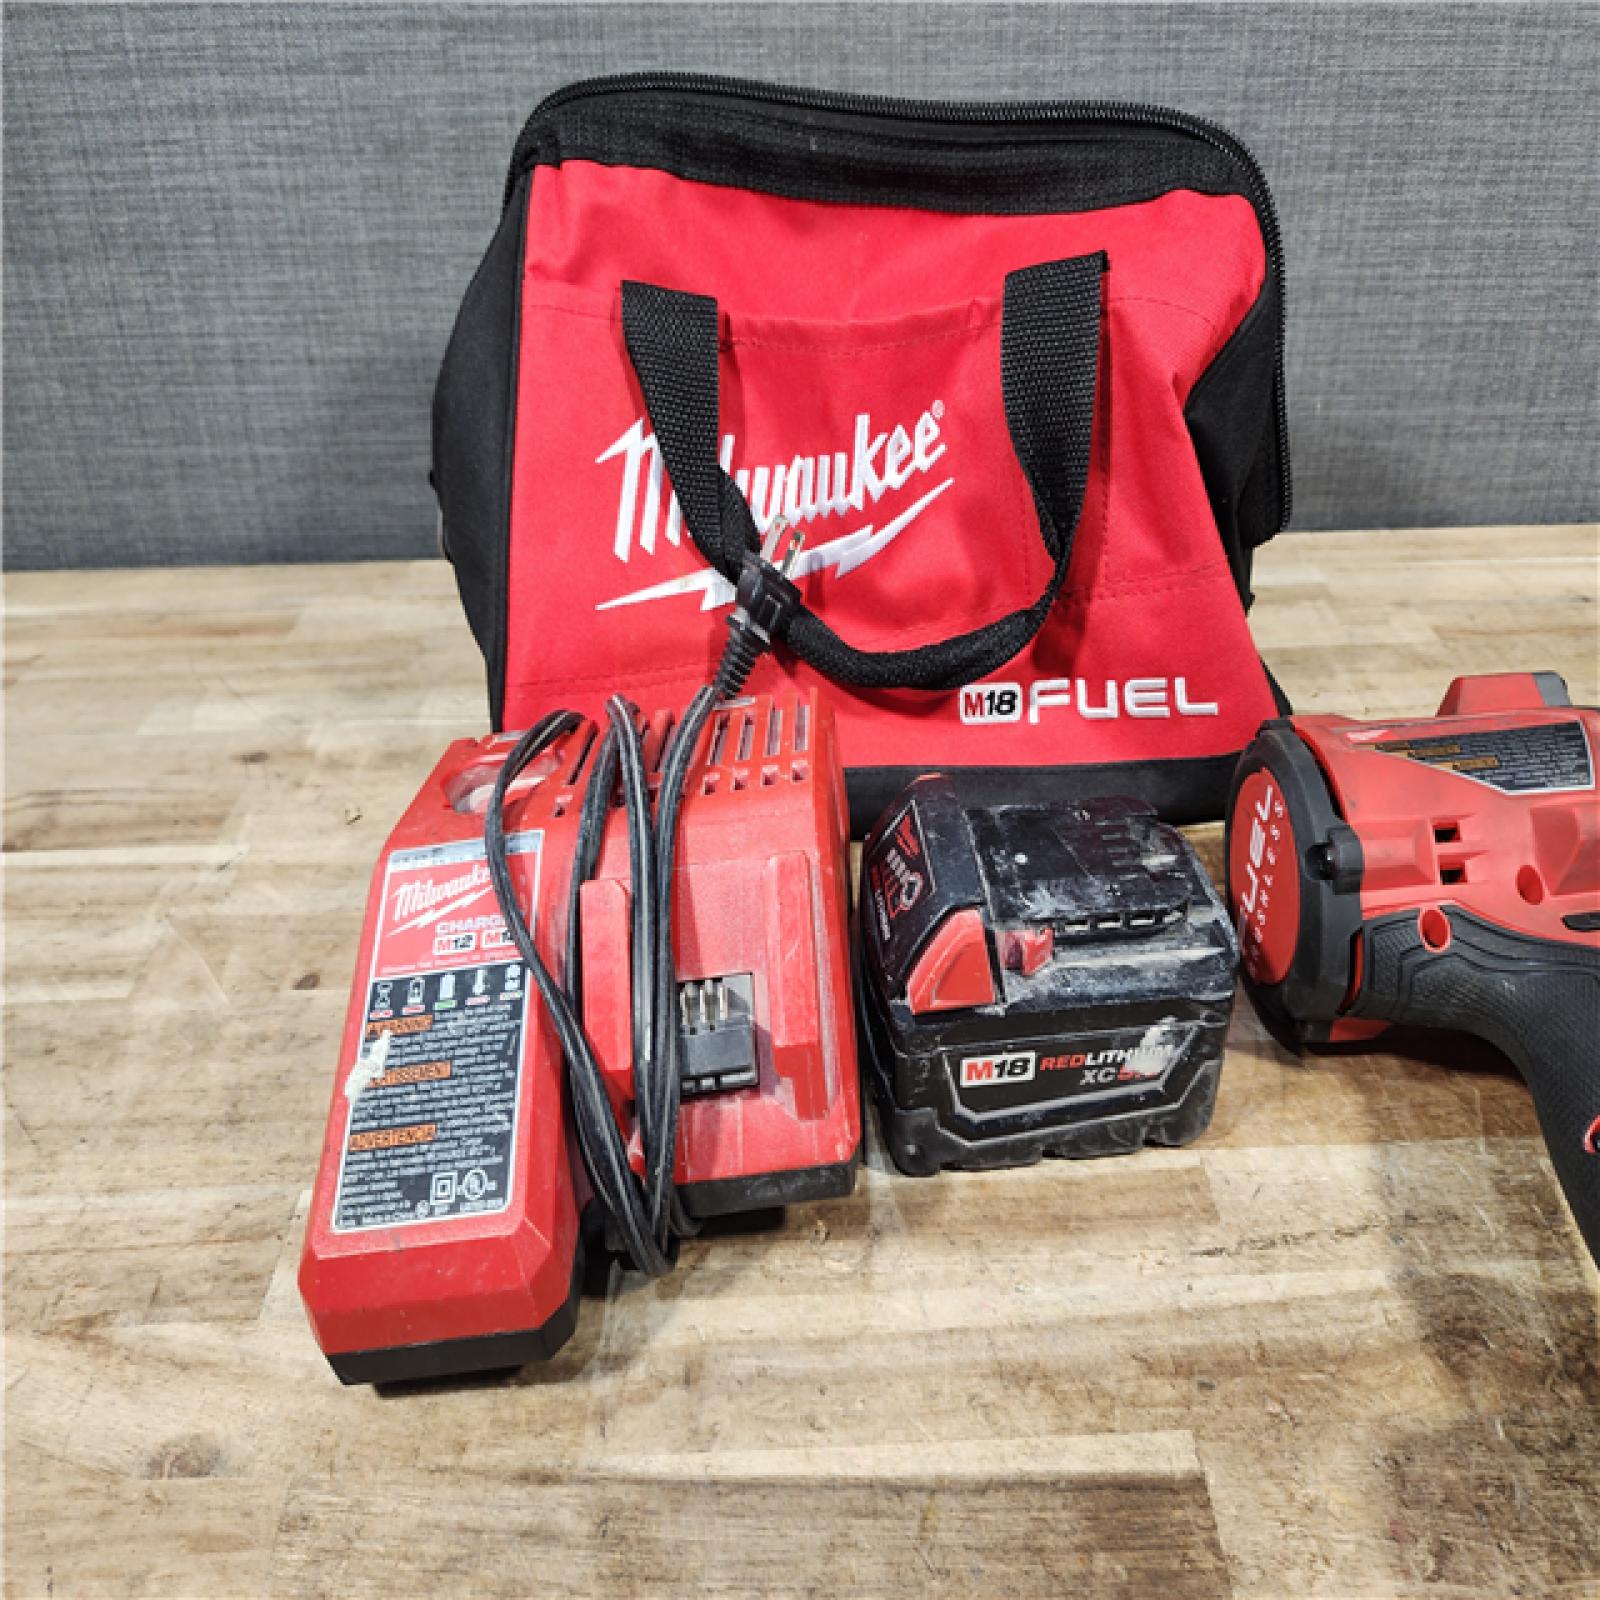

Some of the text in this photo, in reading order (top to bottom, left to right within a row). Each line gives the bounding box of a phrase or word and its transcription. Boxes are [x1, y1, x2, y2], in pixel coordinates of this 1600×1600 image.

[963, 676, 1219, 725] M18 FUEL
[435, 913, 506, 935] CHARG
[966, 1058, 1031, 1082] M18
